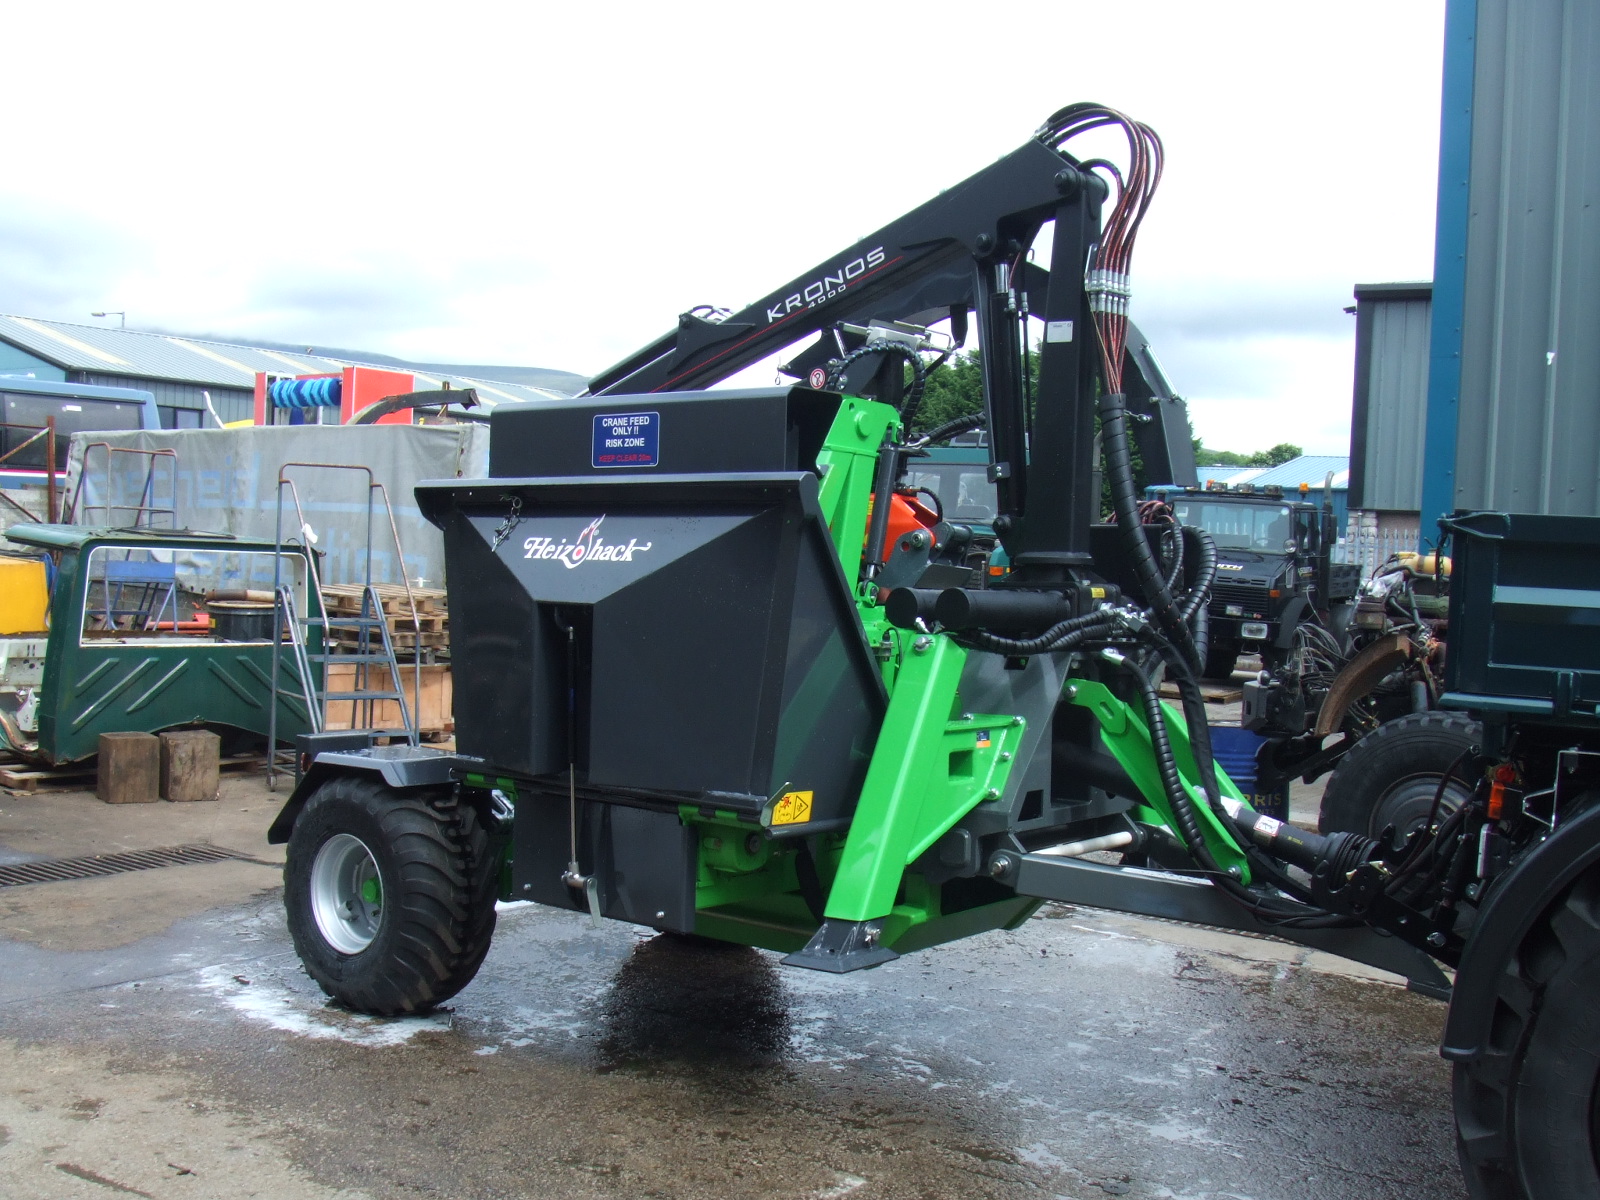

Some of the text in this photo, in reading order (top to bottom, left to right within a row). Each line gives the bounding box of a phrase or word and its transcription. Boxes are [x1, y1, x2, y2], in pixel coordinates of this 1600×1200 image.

[767, 246, 886, 323] KRONOS
[807, 284, 847, 308] 4000
[602, 416, 650, 427] CRANE FEED
[612, 426, 633, 436] ONLY
[605, 437, 645, 448] RISK ZONE
[599, 454, 616, 462] KEEP
[616, 453, 637, 462] CLEAR
[523, 526, 653, 570] Heizohack
